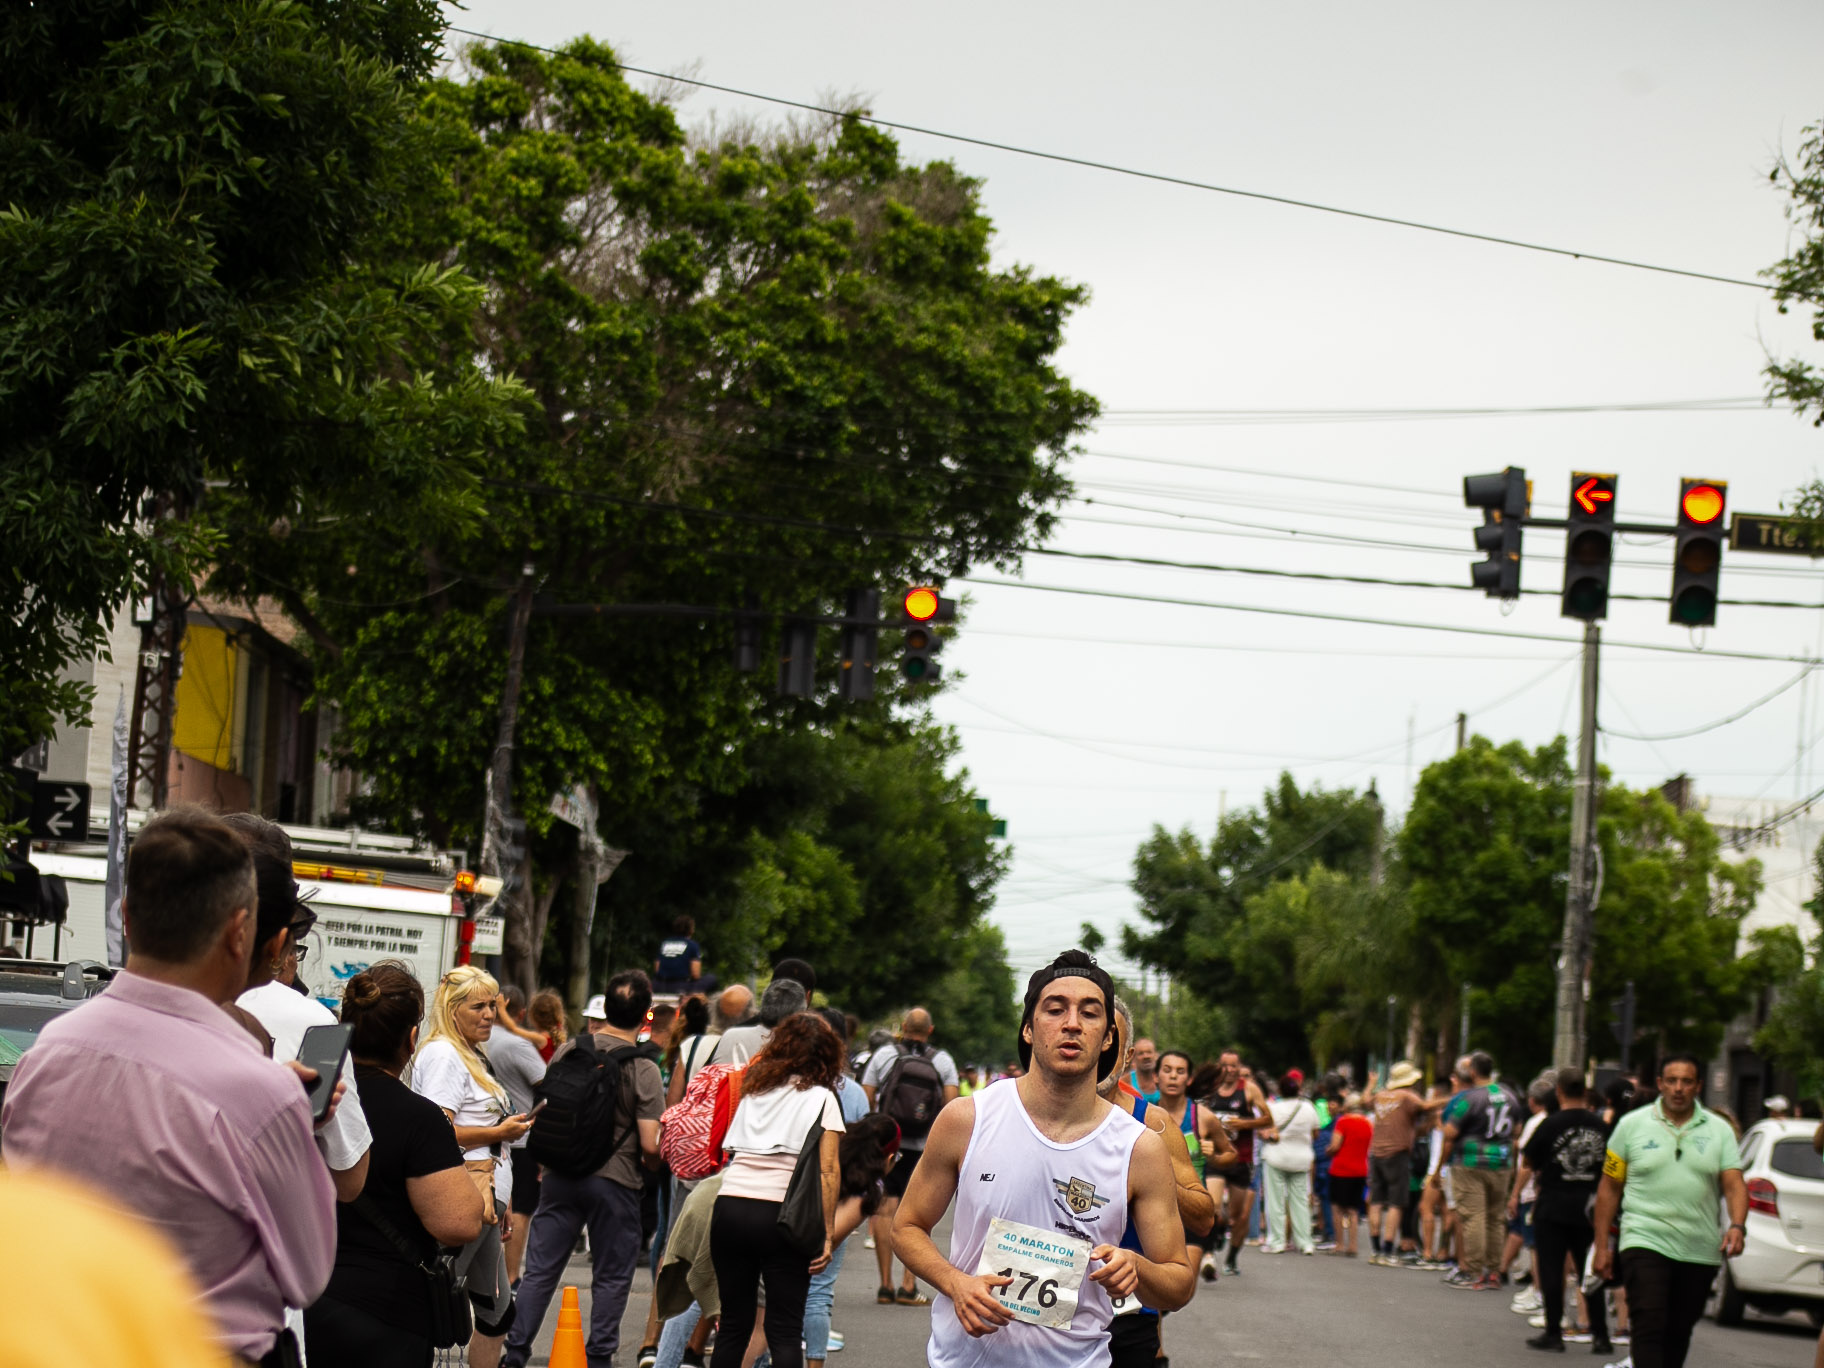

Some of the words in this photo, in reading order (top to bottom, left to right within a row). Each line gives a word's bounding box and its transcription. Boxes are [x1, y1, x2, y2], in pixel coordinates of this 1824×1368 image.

[1759, 522, 1804, 548] Tte.
[347, 922, 363, 934] POR
[365, 924, 375, 935] LA
[407, 928, 423, 939] HOY
[328, 936, 334, 946] Y
[334, 937, 368, 950] SIEMPRE
[371, 940, 386, 951] POR
[388, 942, 398, 952] LA
[399, 943, 418, 954] VIDA
[1486, 1104, 1512, 1138] 16
[1071, 1197, 1086, 1208] 40
[997, 1243, 1033, 1258] EMPALME
[1034, 1253, 1074, 1268] GRANEROS
[1003, 1232, 1017, 1243] 40
[1019, 1236, 1075, 1258] MARATON
[997, 1267, 1059, 1308] 176
[1010, 1302, 1020, 1311] DEL
[1020, 1305, 1041, 1316] VECINO
